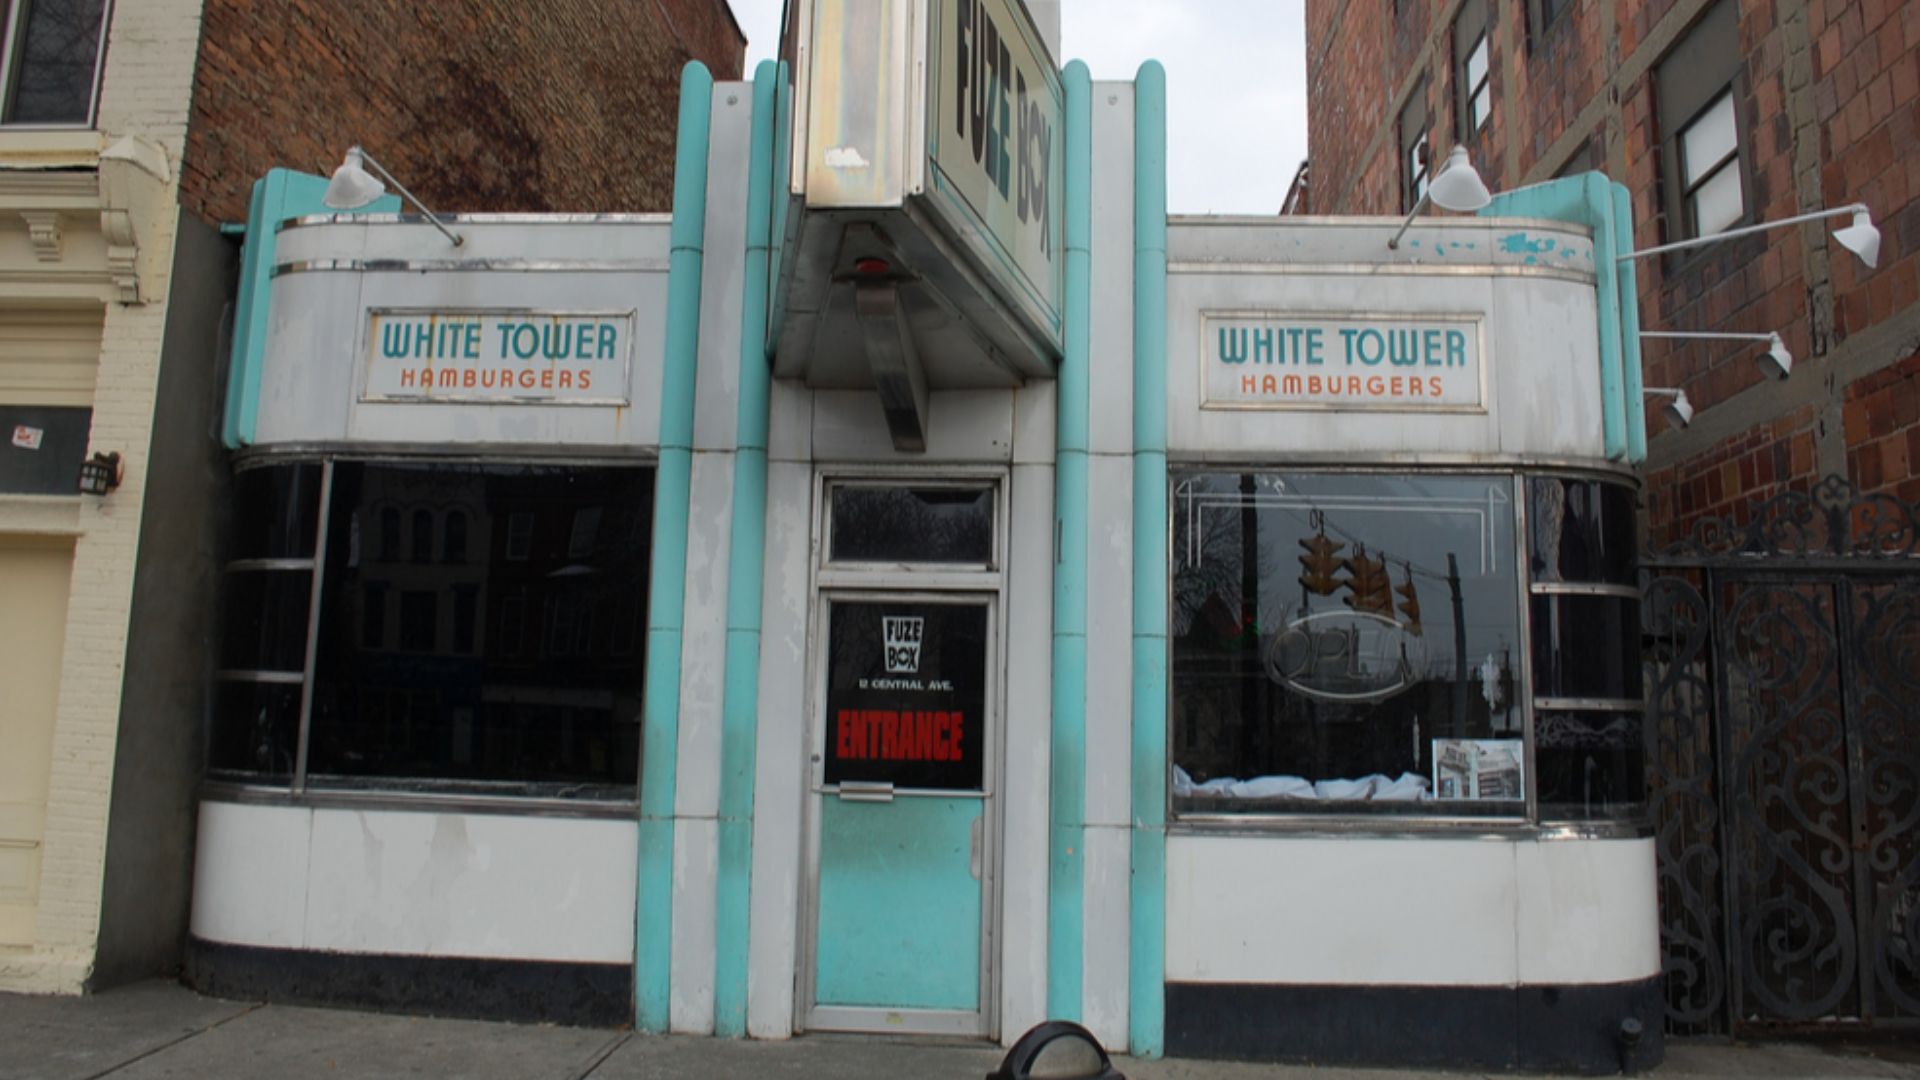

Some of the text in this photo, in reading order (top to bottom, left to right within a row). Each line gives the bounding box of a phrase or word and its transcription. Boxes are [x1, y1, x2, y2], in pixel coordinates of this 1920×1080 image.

[957, 0, 1051, 262] FUZE BOX
[382, 322, 616, 360] WHITE TOWER
[1219, 327, 1466, 367] WHITE TOWER
[401, 368, 591, 390] HAMBURGERS
[1241, 374, 1442, 397] HAMBURGERS
[887, 620, 921, 642] FUZE
[888, 647, 917, 671] BOX
[858, 679, 868, 690] 12
[871, 679, 924, 691] CENTRAL
[836, 709, 964, 761] ENTRANCE
